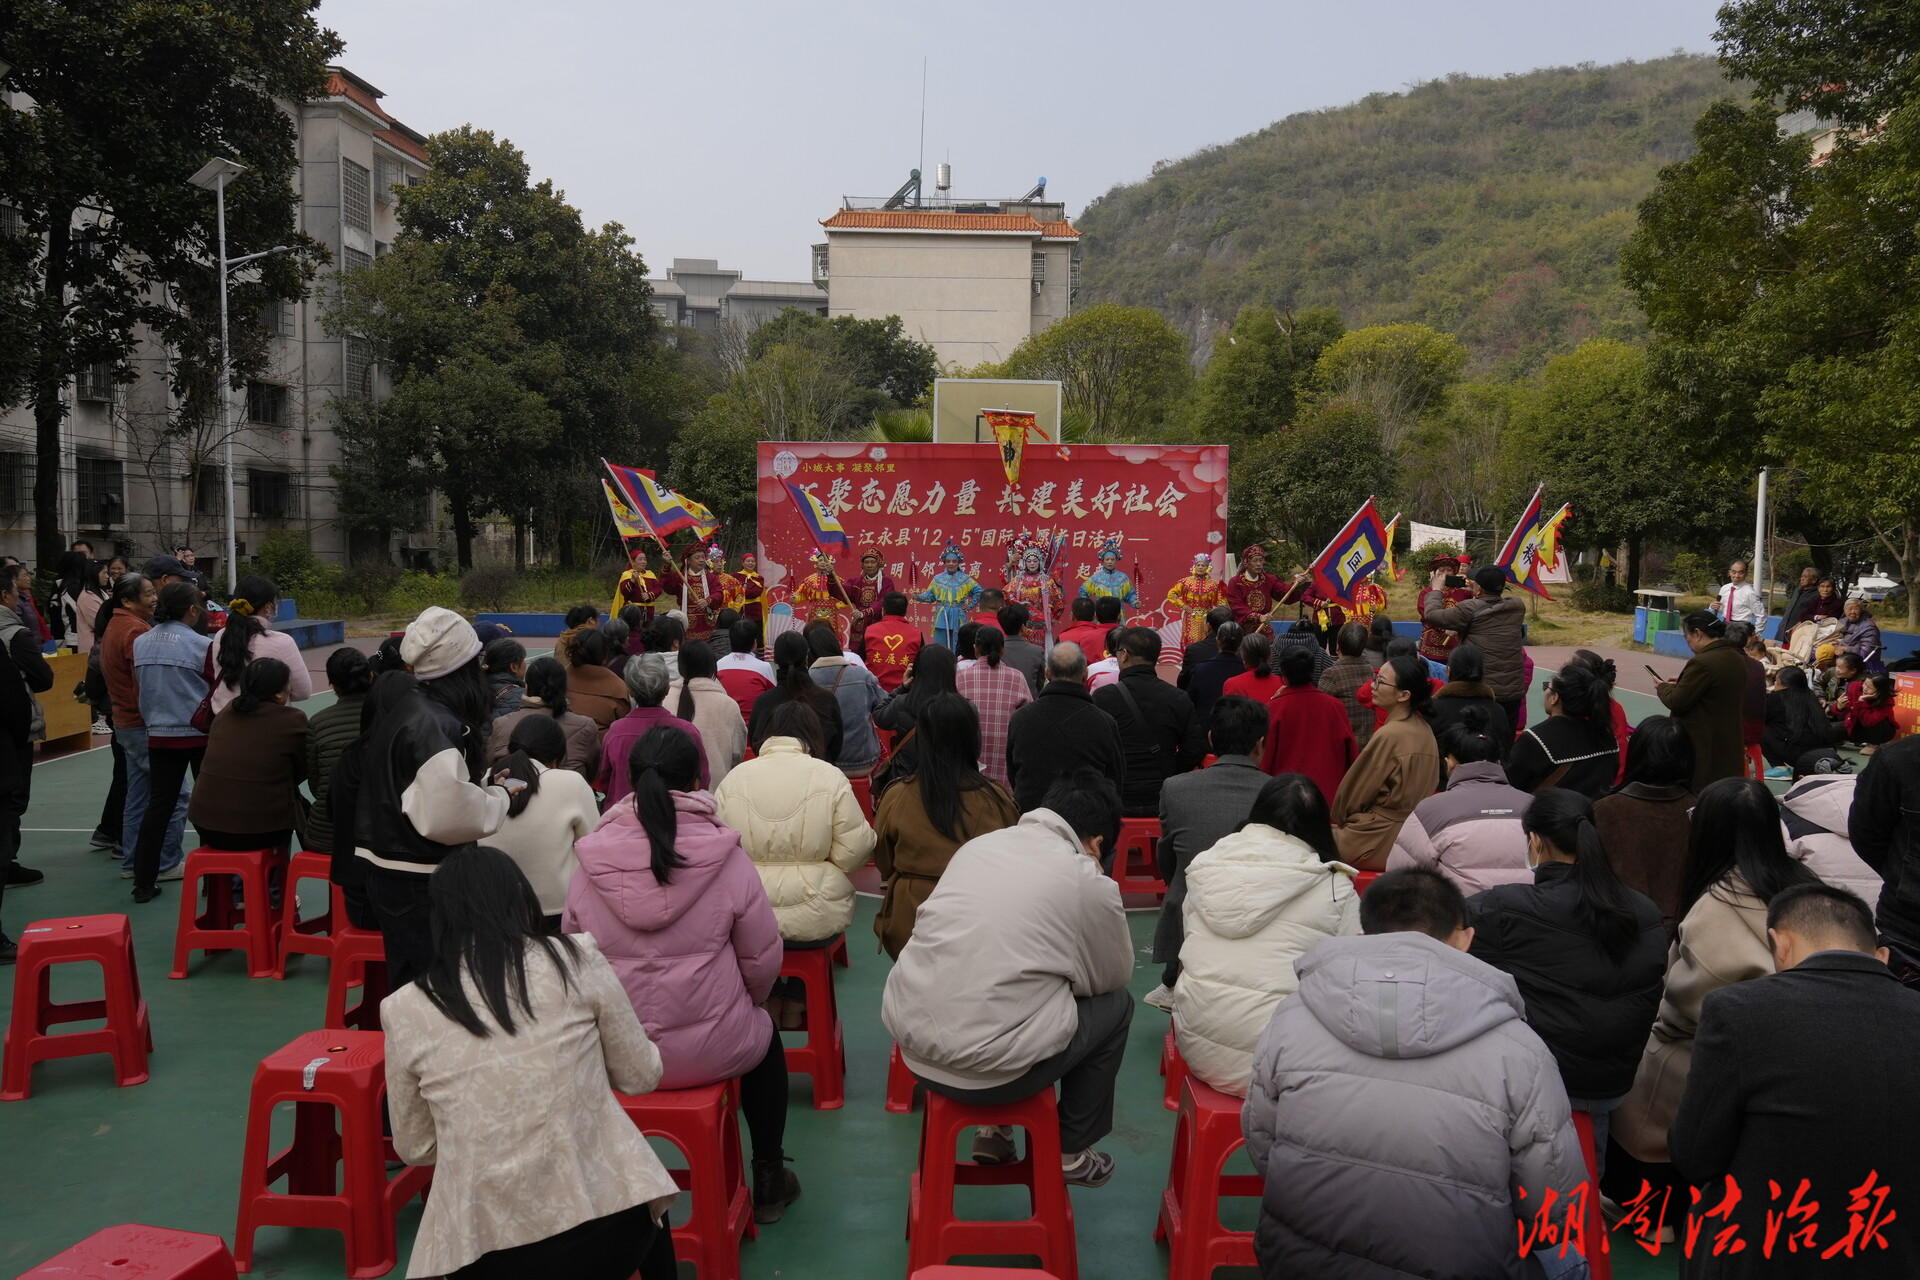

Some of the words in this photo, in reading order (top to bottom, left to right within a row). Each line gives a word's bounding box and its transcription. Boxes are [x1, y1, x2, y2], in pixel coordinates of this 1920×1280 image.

[802, 462, 846, 473] 小城大事
[851, 462, 896, 473] 凝聚邻里
[996, 477, 1188, 520] 共建美好社会
[872, 651, 911, 667] 志愿者
